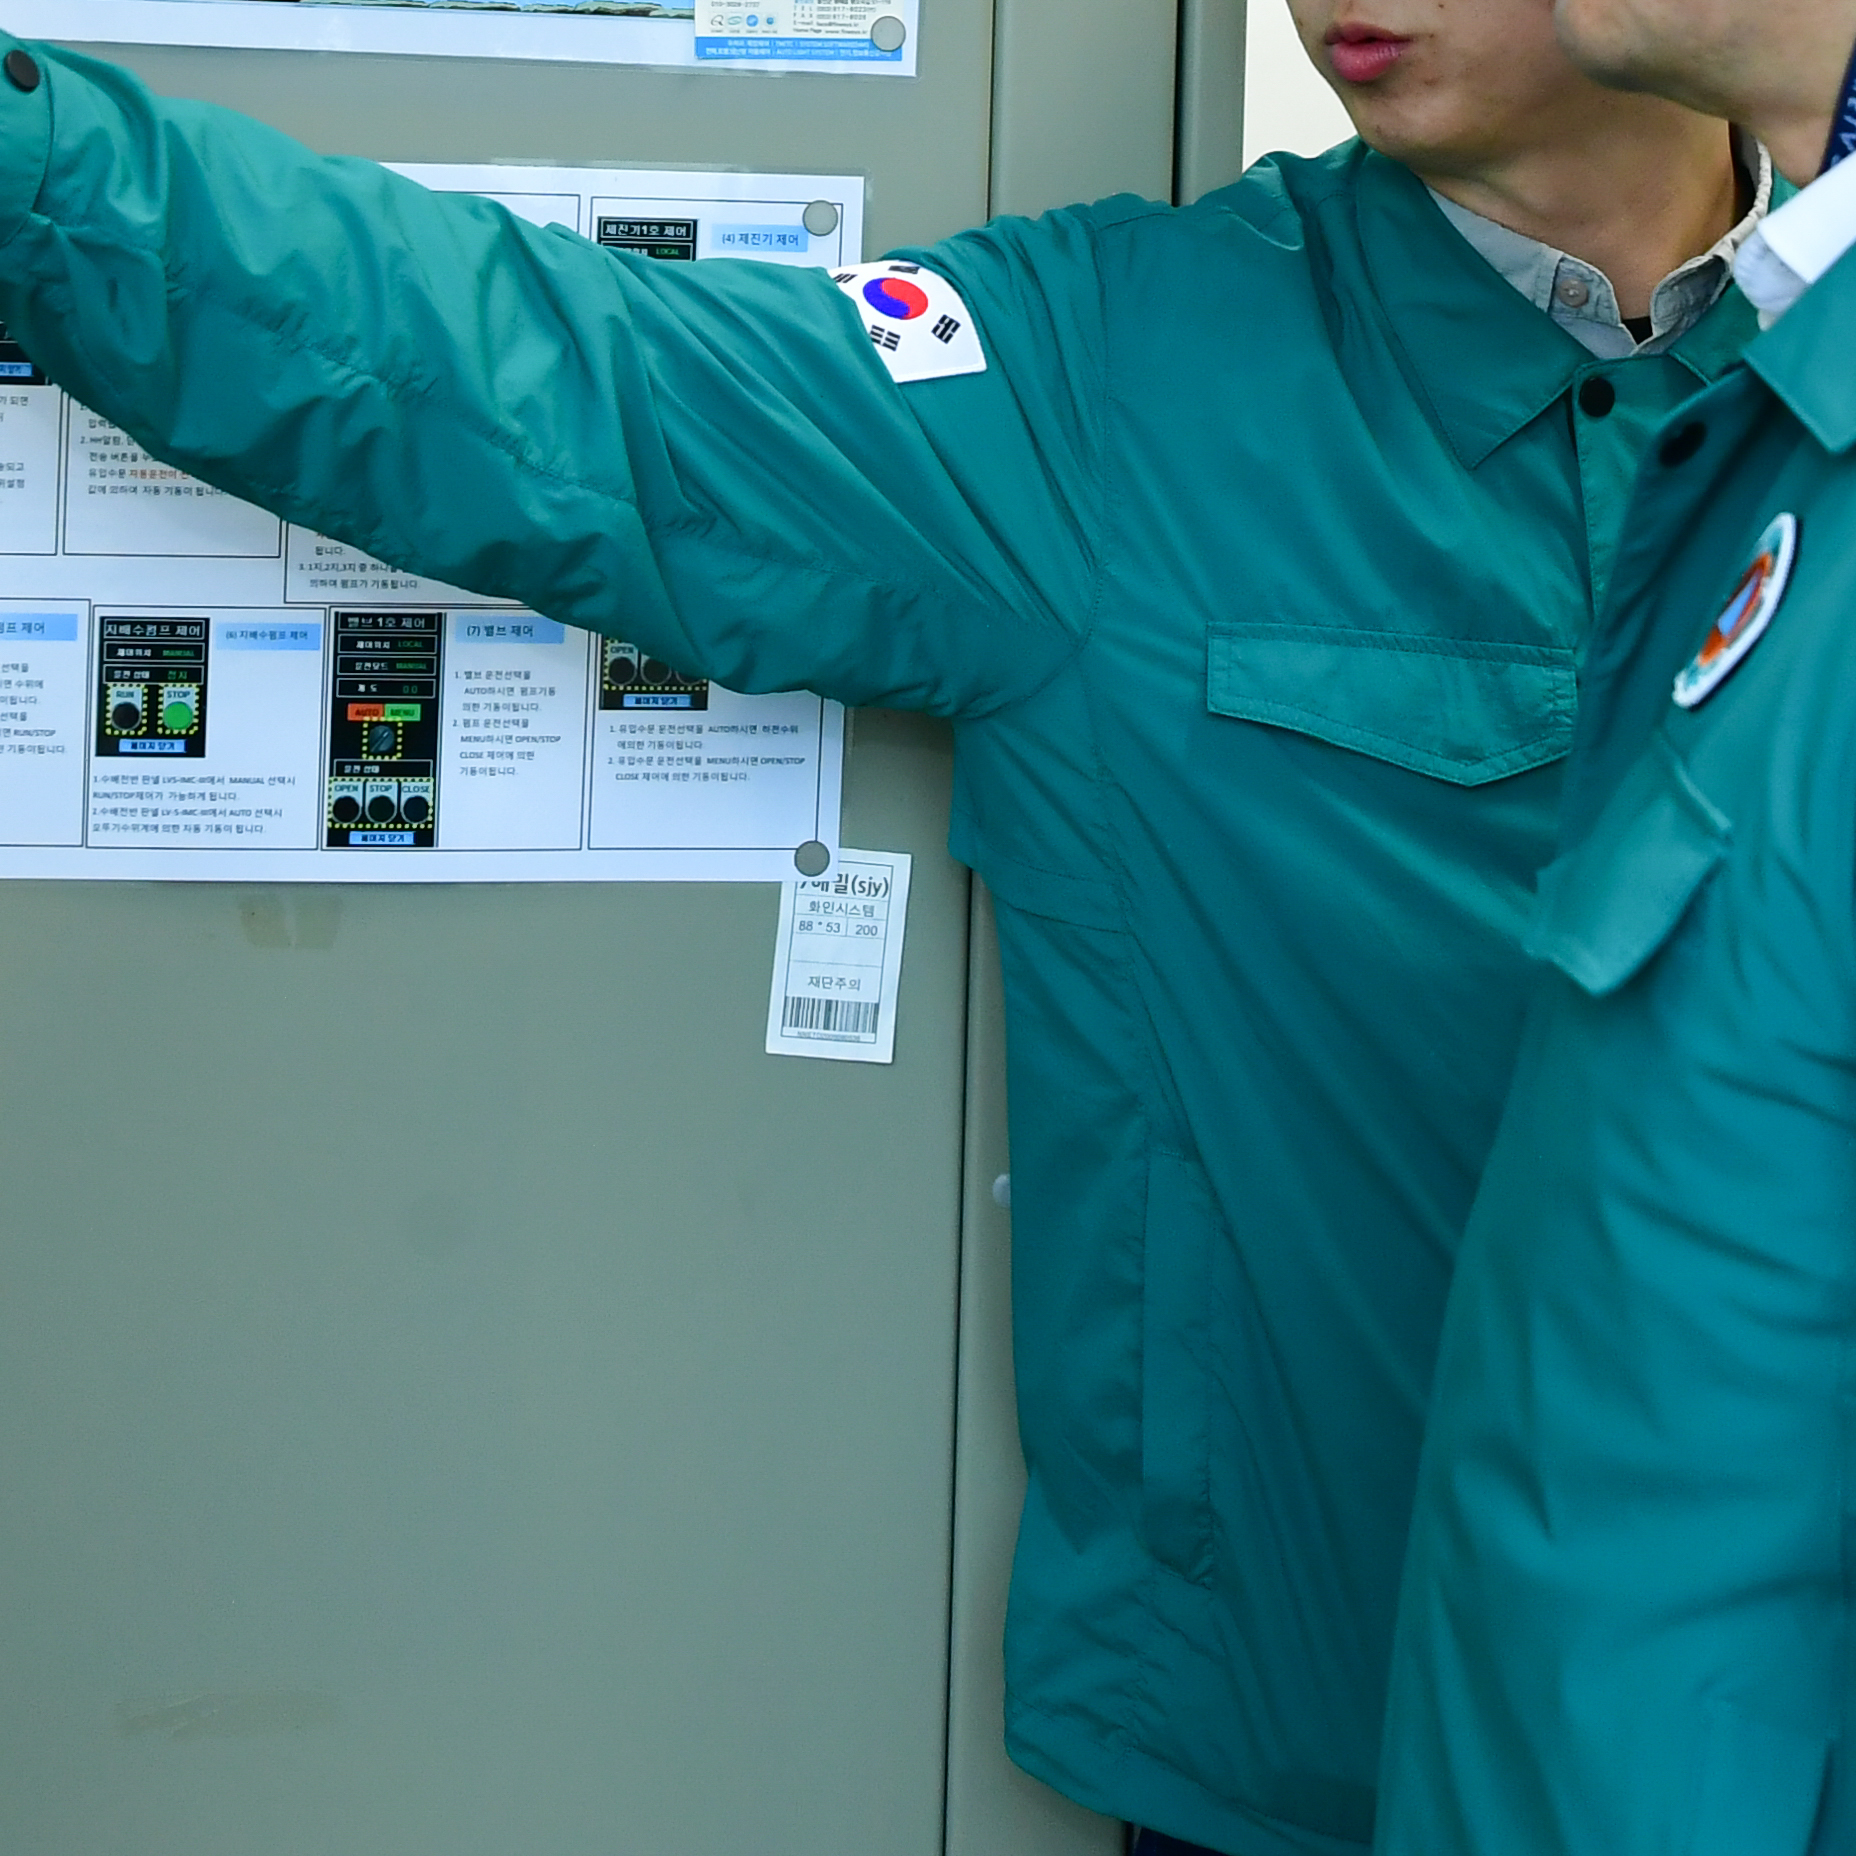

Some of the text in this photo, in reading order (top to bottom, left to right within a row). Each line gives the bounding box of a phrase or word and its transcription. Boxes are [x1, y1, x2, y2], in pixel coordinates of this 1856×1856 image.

[605, 225, 686, 236] 제진기1호 제어
[722, 234, 798, 245] (4) 제진기 제어
[22, 622, 45, 634] 제어
[377, 618, 424, 628] 1호 제어
[105, 625, 200, 636] 지배수펌프 제어
[290, 632, 308, 640] 제어
[467, 625, 533, 637] (7) 밸브 제어
[402, 785, 430, 793] CLOSE
[809, 901, 875, 918] 화인시스템
[799, 921, 841, 933] 88 53
[855, 924, 878, 936] 200
[808, 976, 860, 991] 재단주의
